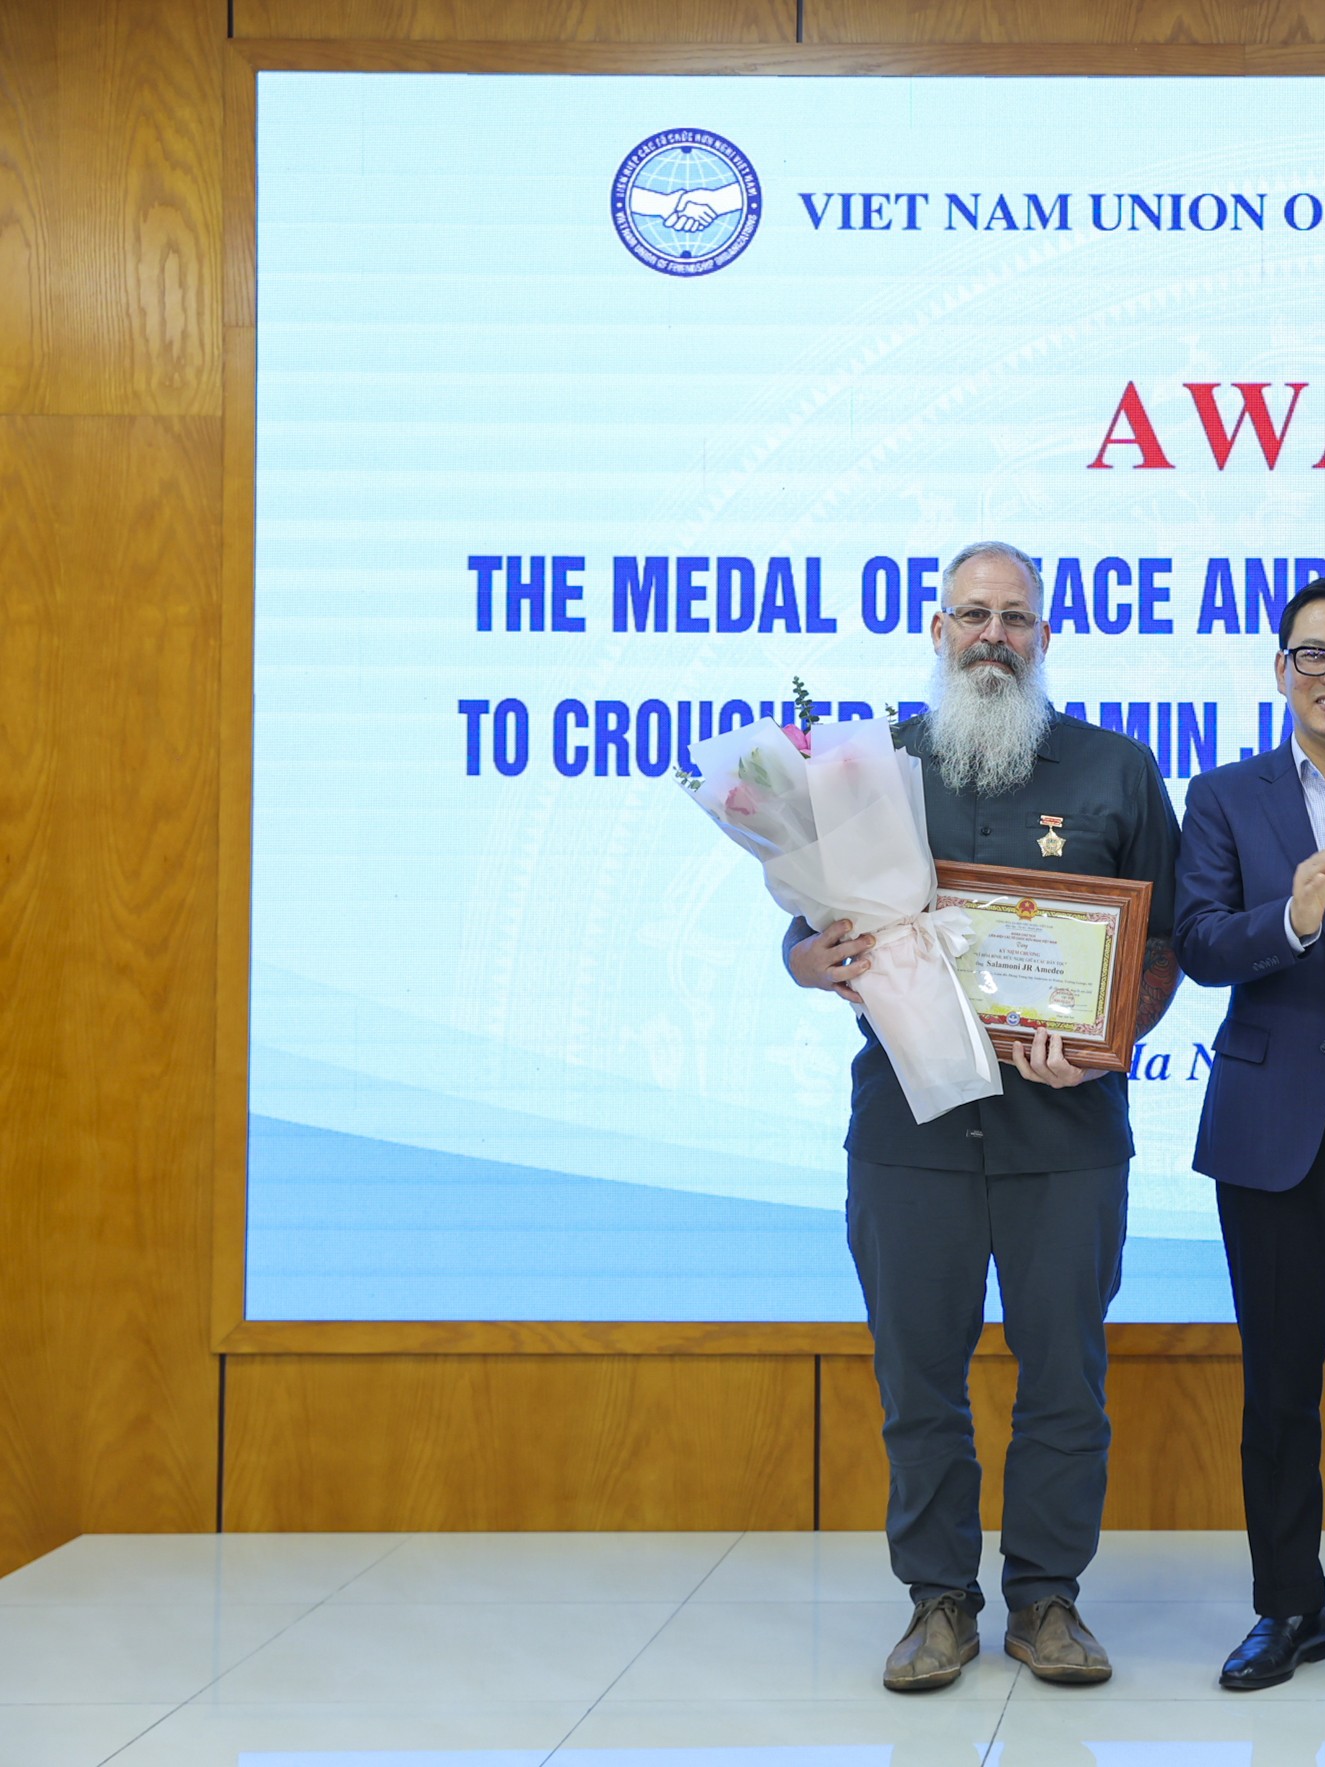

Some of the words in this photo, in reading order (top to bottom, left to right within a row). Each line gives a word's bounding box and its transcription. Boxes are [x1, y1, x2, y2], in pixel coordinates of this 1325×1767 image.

[798, 193, 929, 231] VIET
[945, 193, 1071, 231] NAM
[1090, 193, 1268, 232] UNION
[468, 556, 587, 635] THE
[613, 557, 837, 635] MEDAL
[861, 556, 940, 635] OF
[1035, 556, 1175, 636] ACE
[459, 698, 530, 778] TO
[986, 959, 1021, 970] Salamoni
[1021, 963, 1033, 972] JR
[1035, 965, 1065, 975] Amedeo
